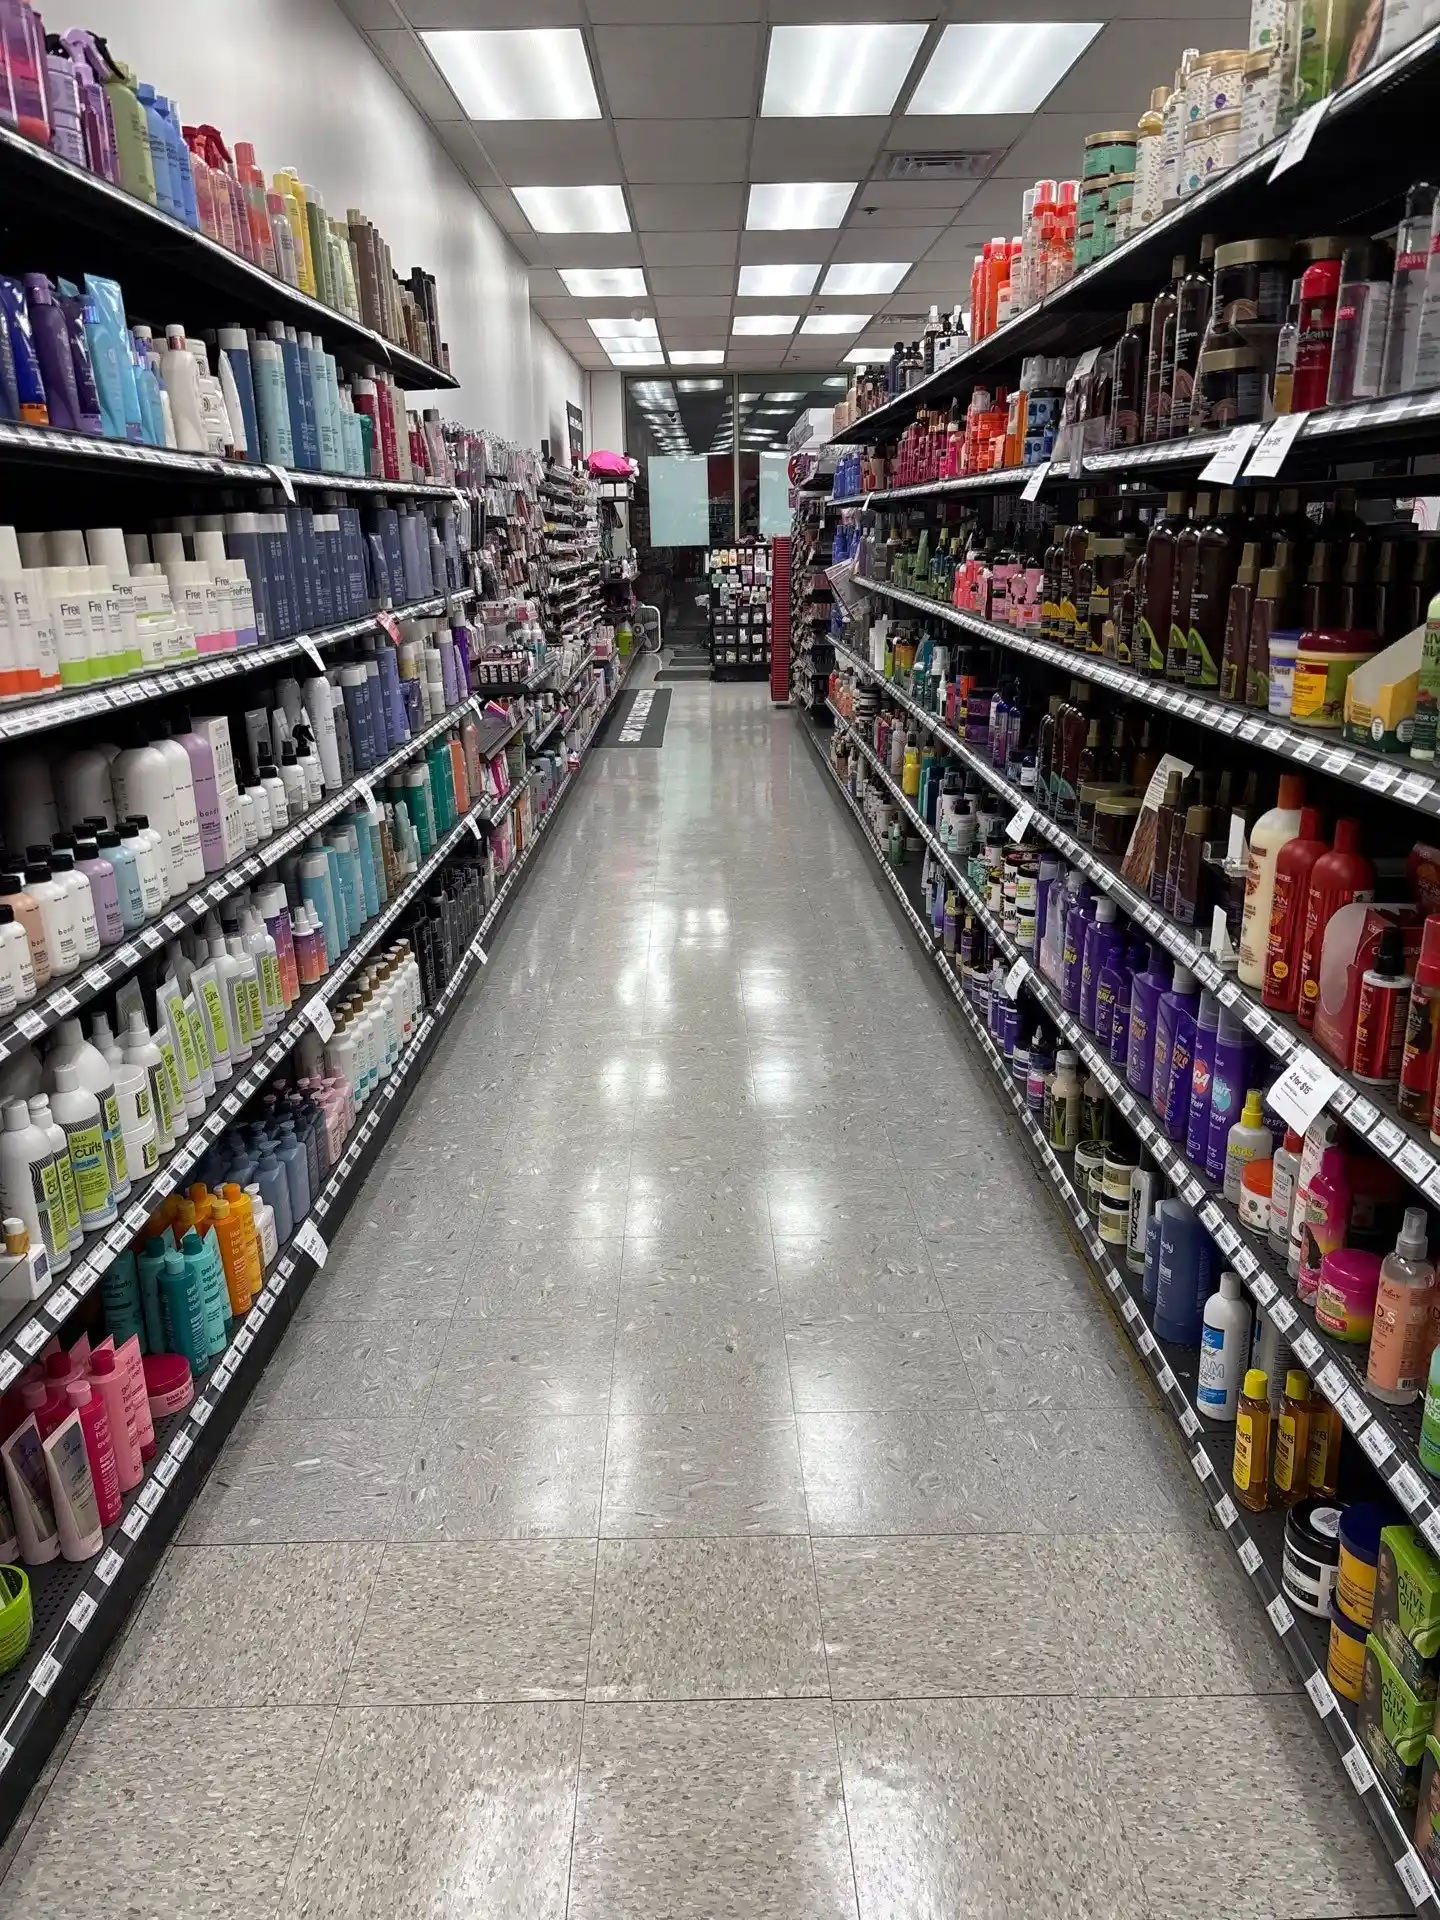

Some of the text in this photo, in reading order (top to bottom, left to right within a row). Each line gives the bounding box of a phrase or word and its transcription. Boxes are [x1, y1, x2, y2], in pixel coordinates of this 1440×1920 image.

[1289, 1072, 1297, 1080] 2
[1293, 1074, 1302, 1086] for
[1300, 1082, 1314, 1095] $15
[1397, 1576, 1426, 1615] OLIVE
[1382, 1682, 1408, 1724] OLIVE
